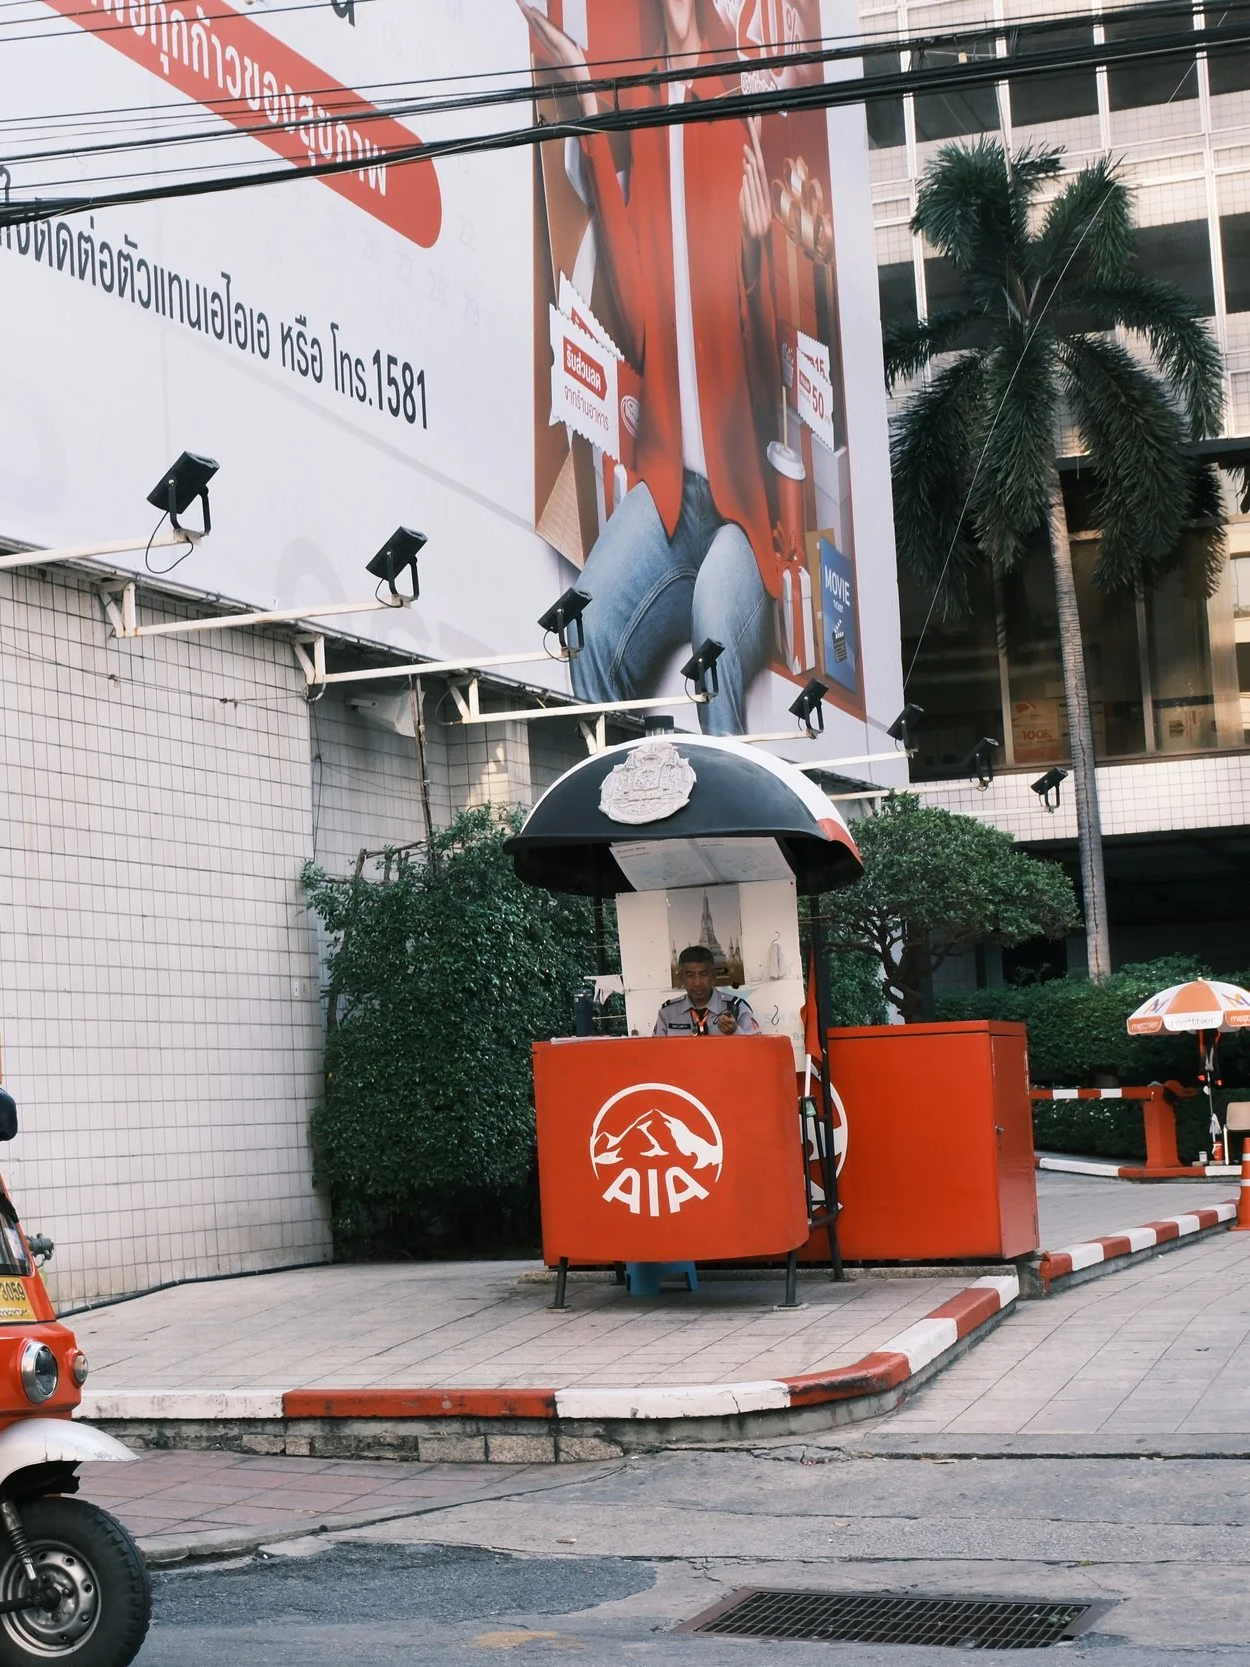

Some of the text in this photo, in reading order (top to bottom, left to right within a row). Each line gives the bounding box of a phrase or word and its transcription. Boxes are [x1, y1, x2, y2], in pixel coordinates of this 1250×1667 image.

[280, 313, 323, 384] หรือ
[330, 321, 428, 430] โทร.1581
[812, 384, 825, 420] 50
[824, 565, 851, 608] MOVIE
[602, 1166, 710, 1217] AIA
